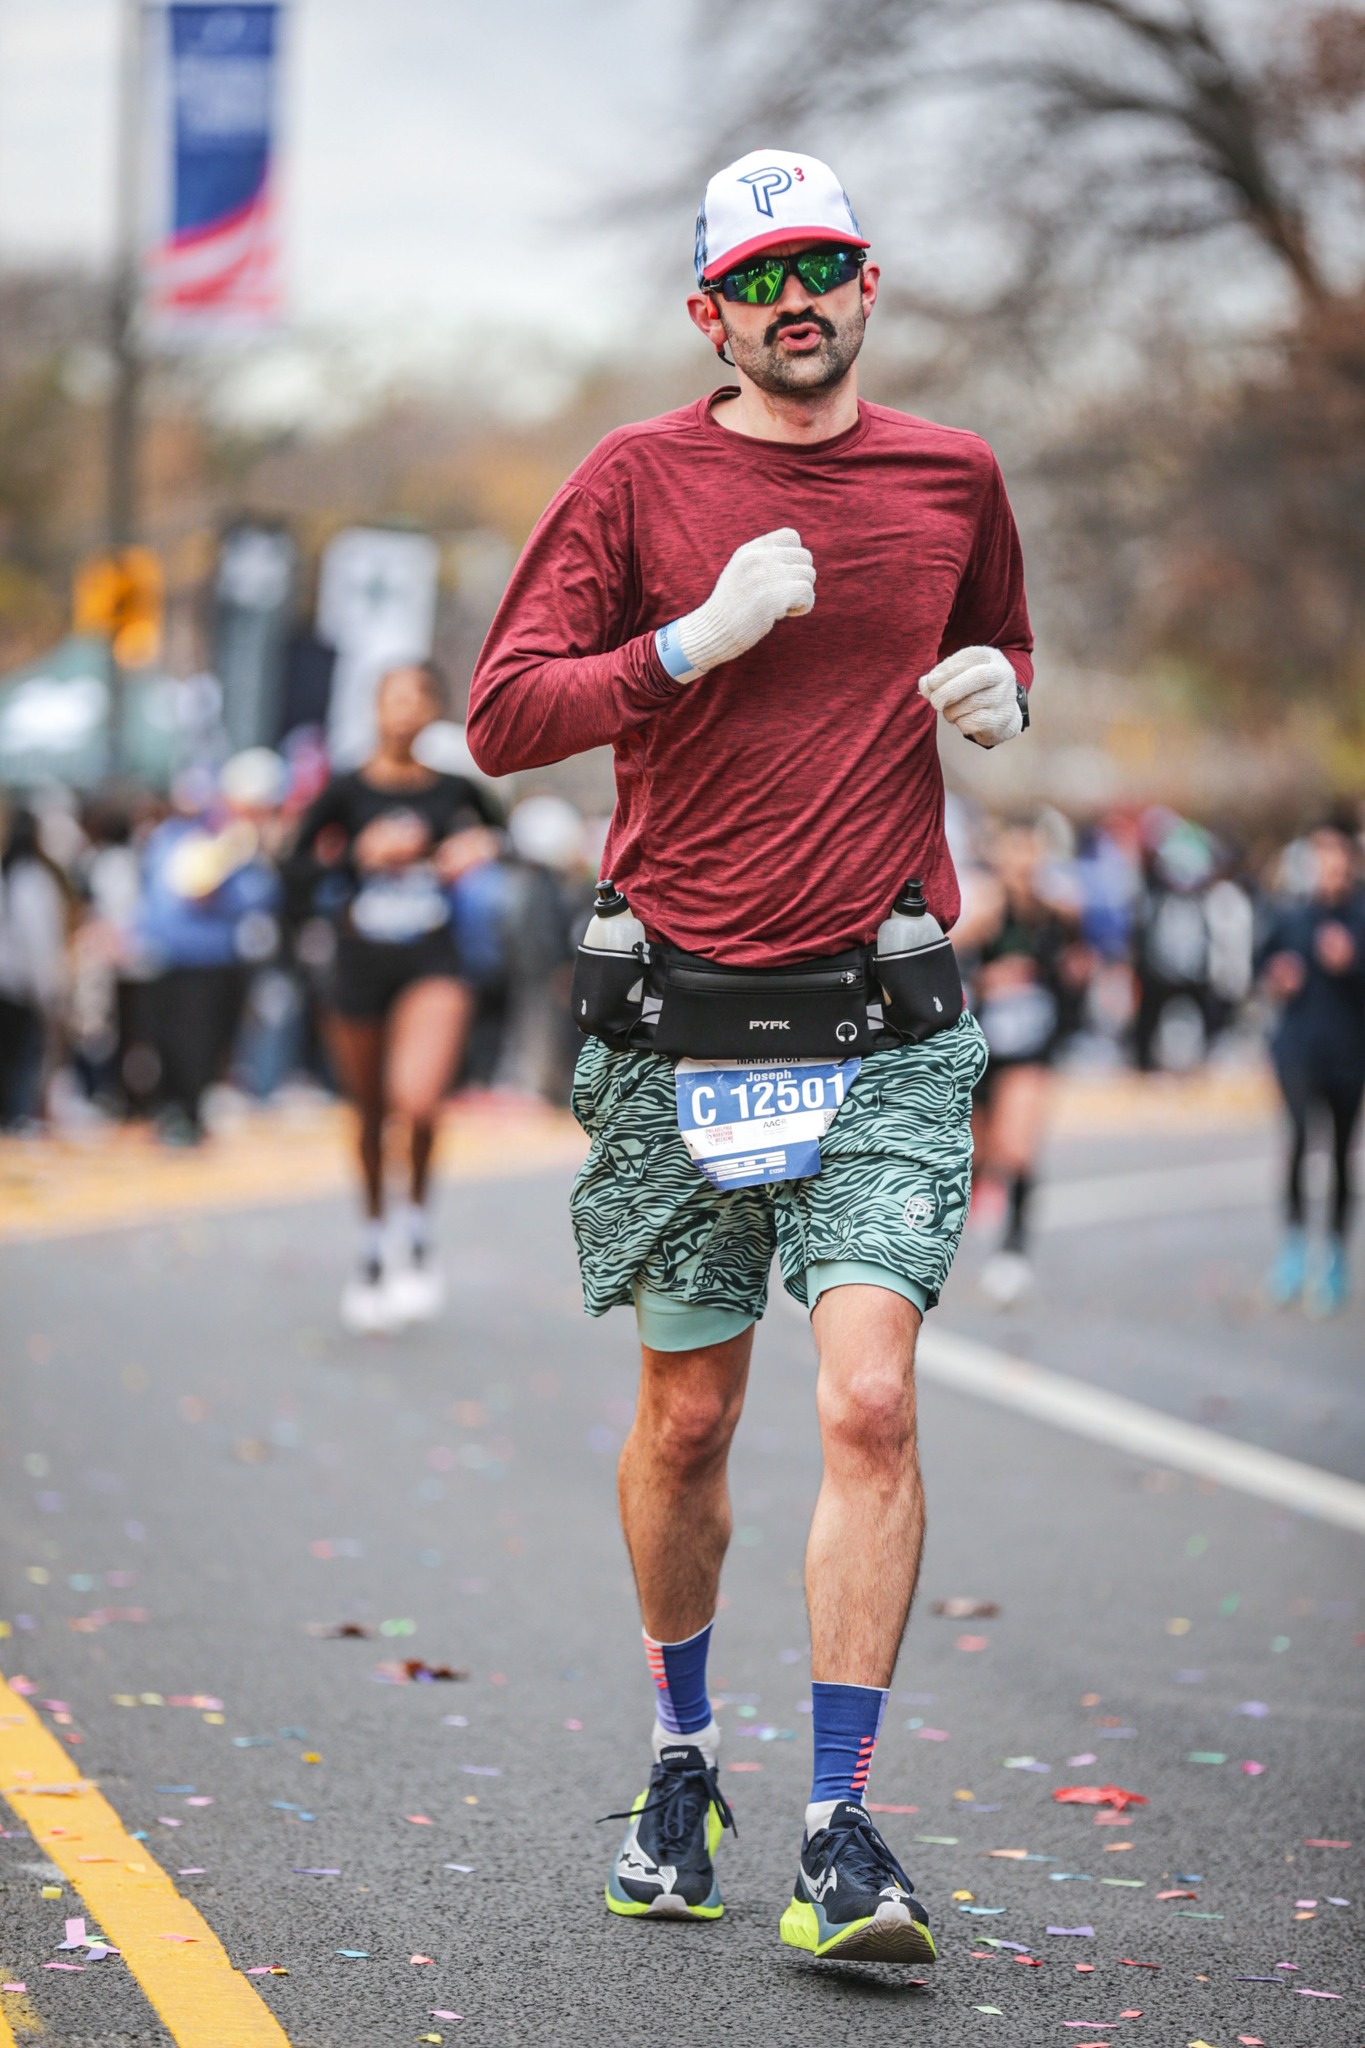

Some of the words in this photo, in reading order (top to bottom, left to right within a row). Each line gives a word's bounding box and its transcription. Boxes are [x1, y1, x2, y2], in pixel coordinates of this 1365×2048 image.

[749, 1020, 790, 1030] PYFK
[746, 1069, 792, 1082] Joseph
[691, 1085, 717, 1126] C
[730, 1072, 844, 1119] 12501
